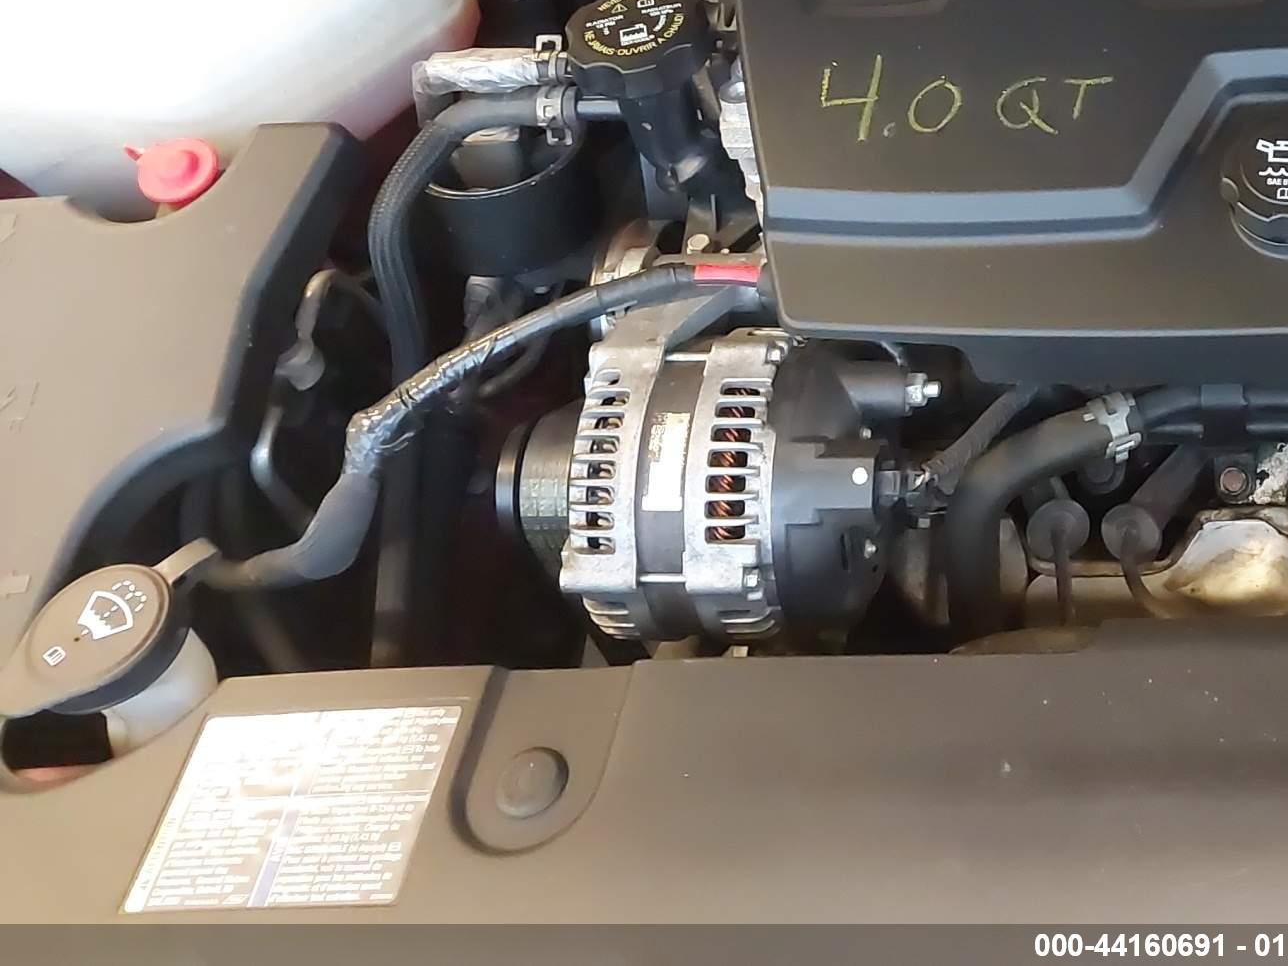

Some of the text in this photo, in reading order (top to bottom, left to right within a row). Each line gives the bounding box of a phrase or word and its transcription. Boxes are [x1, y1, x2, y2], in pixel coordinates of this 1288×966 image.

[585, 15, 624, 28] RADIATOR
[617, 41, 658, 56] OUVRIR
[821, 54, 1114, 141] 4.0 QT
[1266, 177, 1282, 186] SAE
